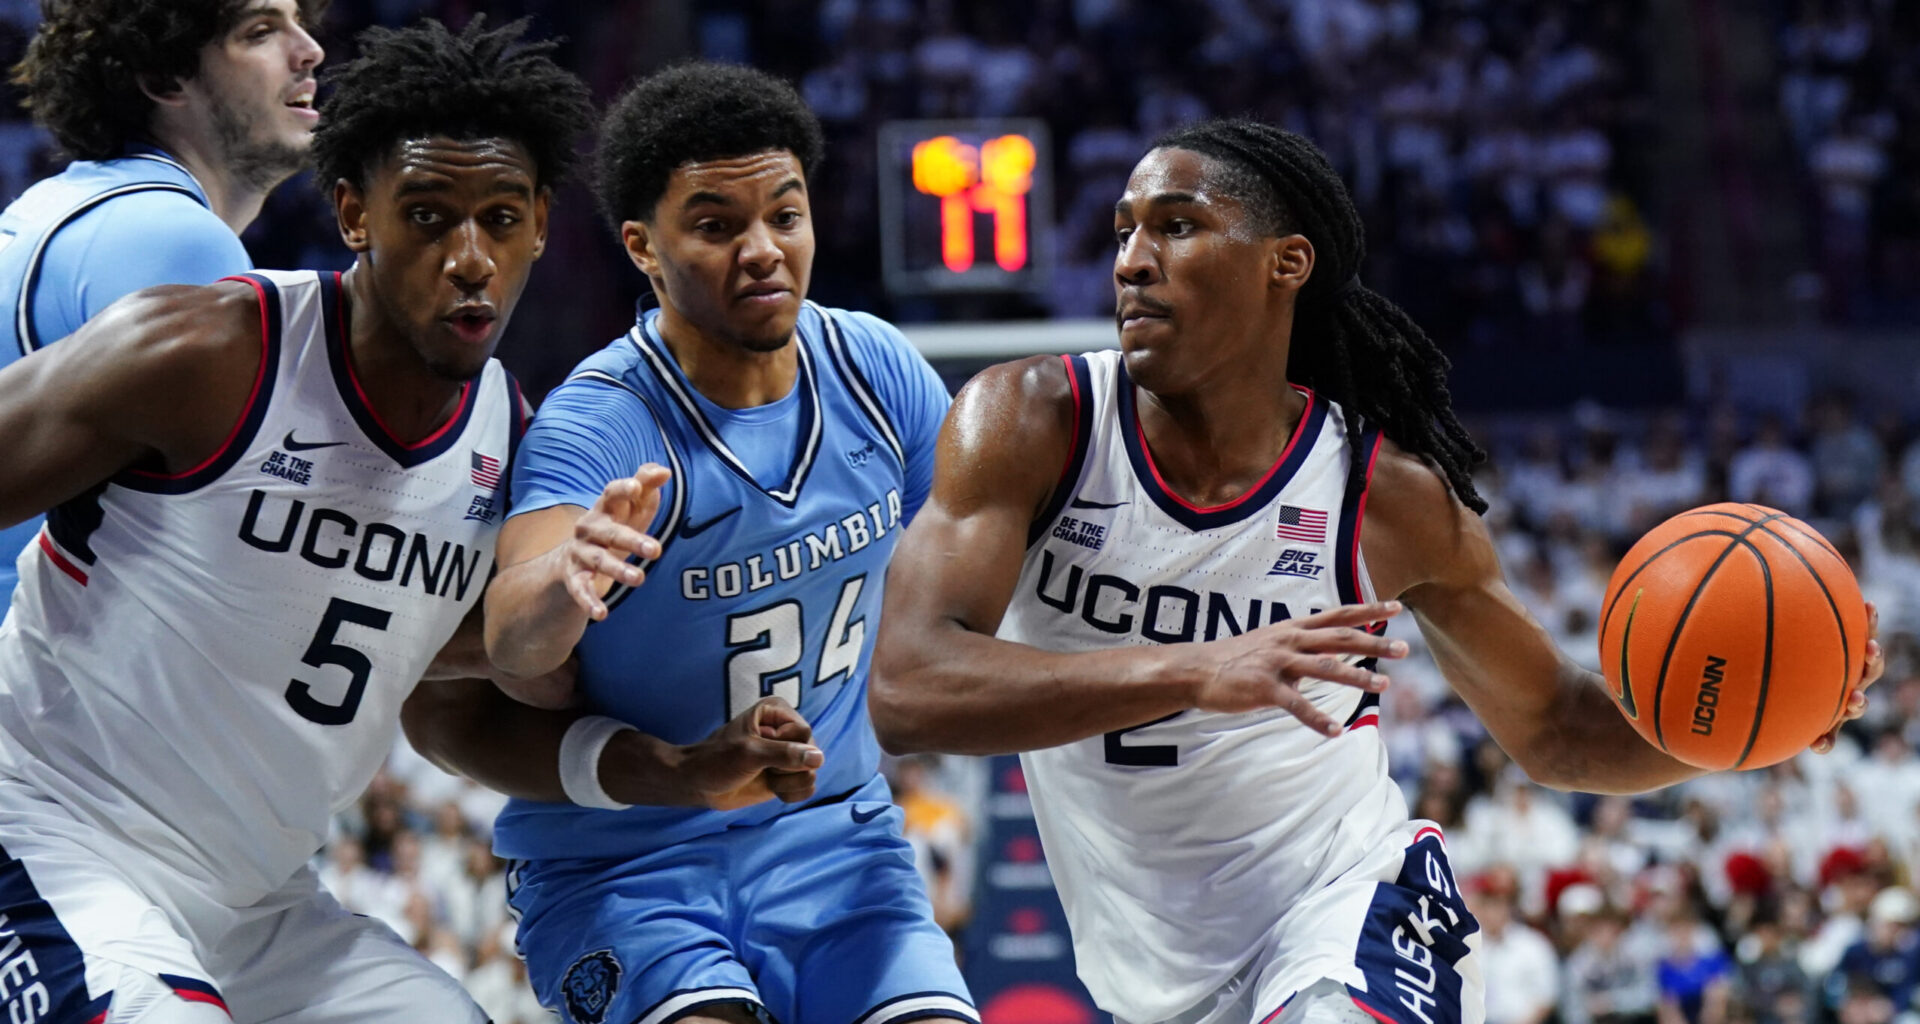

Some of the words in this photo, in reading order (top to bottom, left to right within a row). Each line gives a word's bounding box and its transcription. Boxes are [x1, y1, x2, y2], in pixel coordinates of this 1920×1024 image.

[260, 461, 312, 486] CHANGE
[269, 451, 288, 465] BE
[290, 456, 314, 473] THE
[467, 504, 497, 521] EAST
[472, 495, 494, 509] BIG
[1052, 526, 1105, 551] CHANGE
[1060, 516, 1079, 530] BE
[1080, 521, 1106, 538] THE
[238, 489, 481, 602] UCONN
[681, 486, 901, 600] COLUMBIA
[1271, 560, 1325, 576] EAST
[1279, 549, 1318, 563] BIG
[724, 572, 868, 720] 24
[284, 597, 392, 726] 5
[1691, 655, 1727, 737] UCONN
[1392, 850, 1460, 1024] HUSKS
